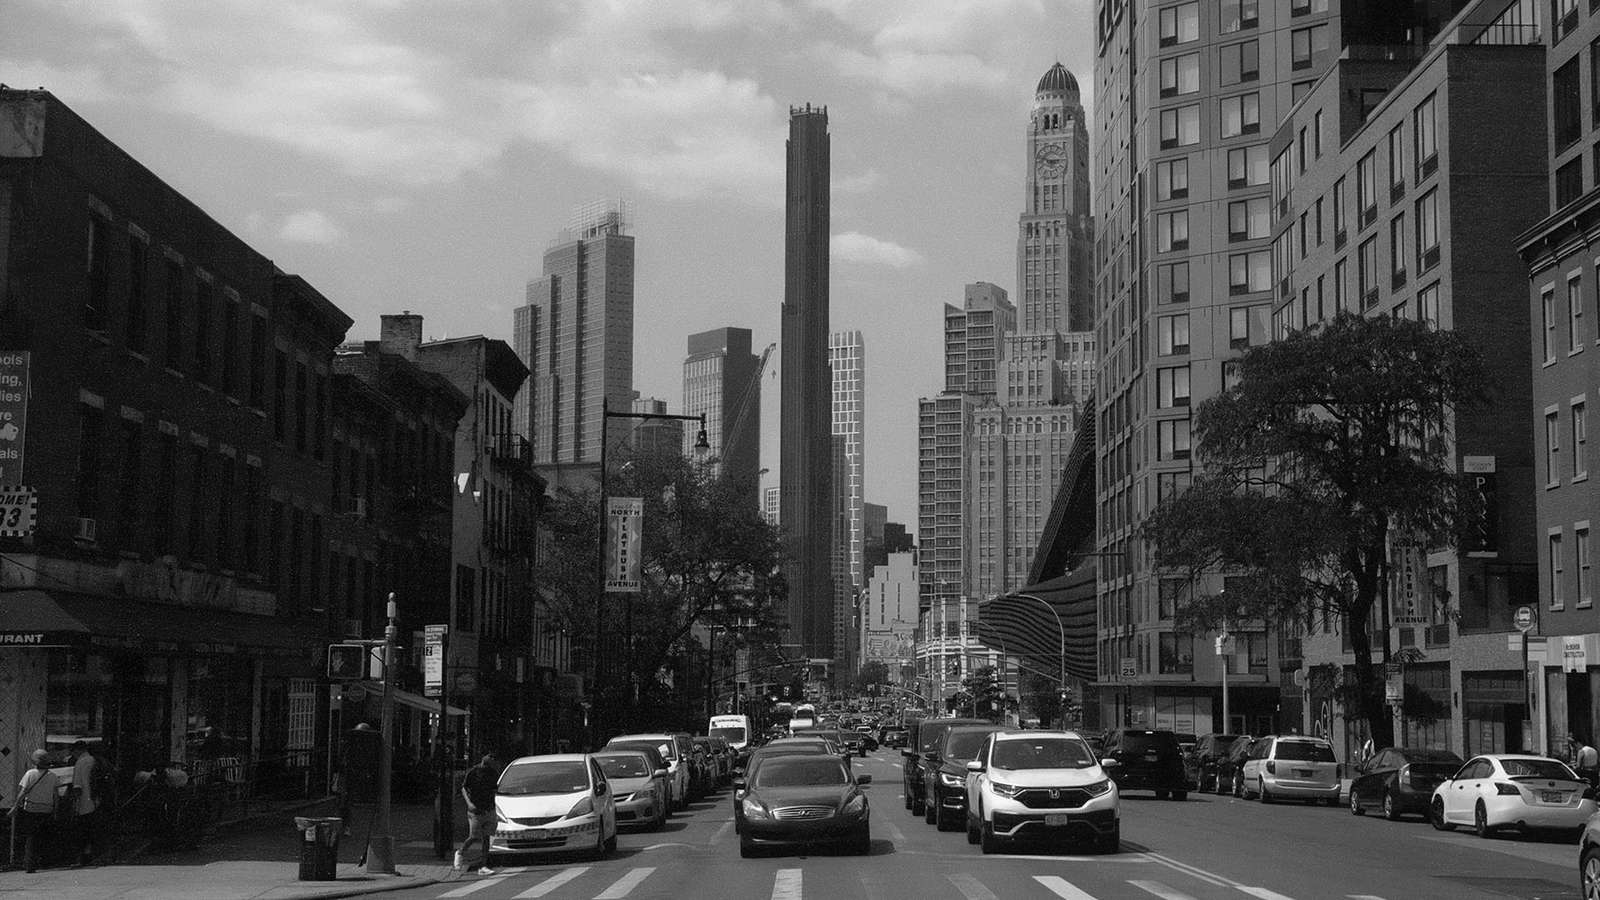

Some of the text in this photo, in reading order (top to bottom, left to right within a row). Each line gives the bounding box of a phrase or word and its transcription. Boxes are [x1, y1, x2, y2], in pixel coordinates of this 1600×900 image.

[0, 354, 24, 366] ols
[620, 516, 628, 580] FLATBUSH
[607, 580, 639, 588] AVENUE
[1394, 616, 1428, 624] AVENUE
[1122, 668, 1136, 677] 25
